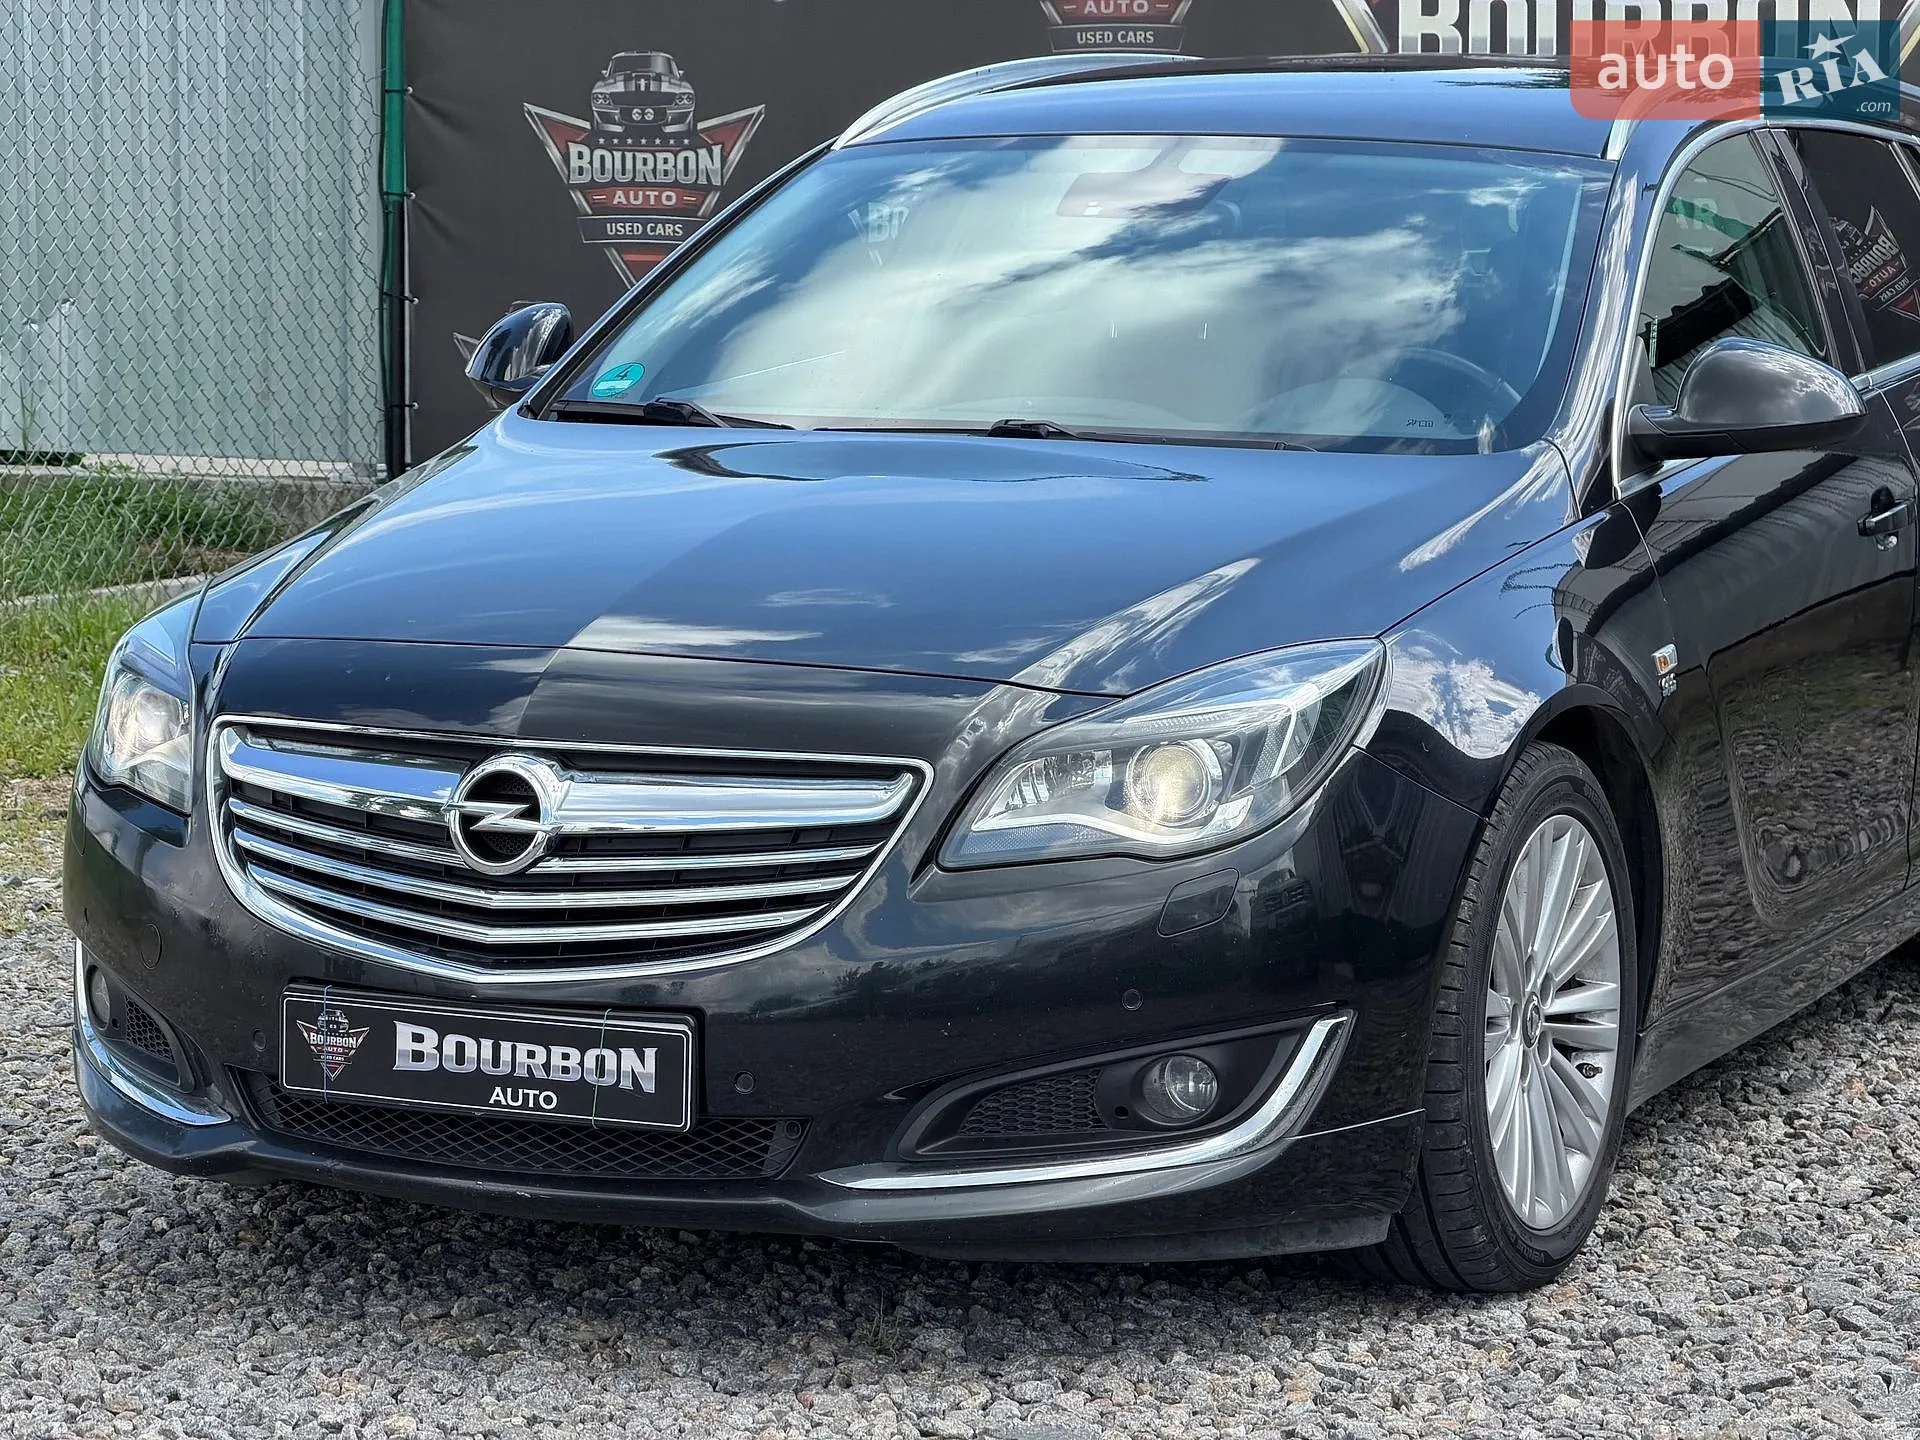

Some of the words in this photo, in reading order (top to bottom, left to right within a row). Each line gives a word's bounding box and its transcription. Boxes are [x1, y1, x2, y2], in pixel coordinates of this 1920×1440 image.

[1084, 0, 1149, 14] AUTO
[1076, 31, 1113, 44] USED
[1117, 31, 1154, 44] CARS
[567, 142, 723, 185] BOURBON
[612, 190, 677, 206] AUTO
[606, 223, 642, 236] USED
[647, 223, 683, 236] CARS
[615, 364, 635, 380] 4
[393, 1020, 658, 1093] BOURBON
[489, 1086, 557, 1110] AUTO
